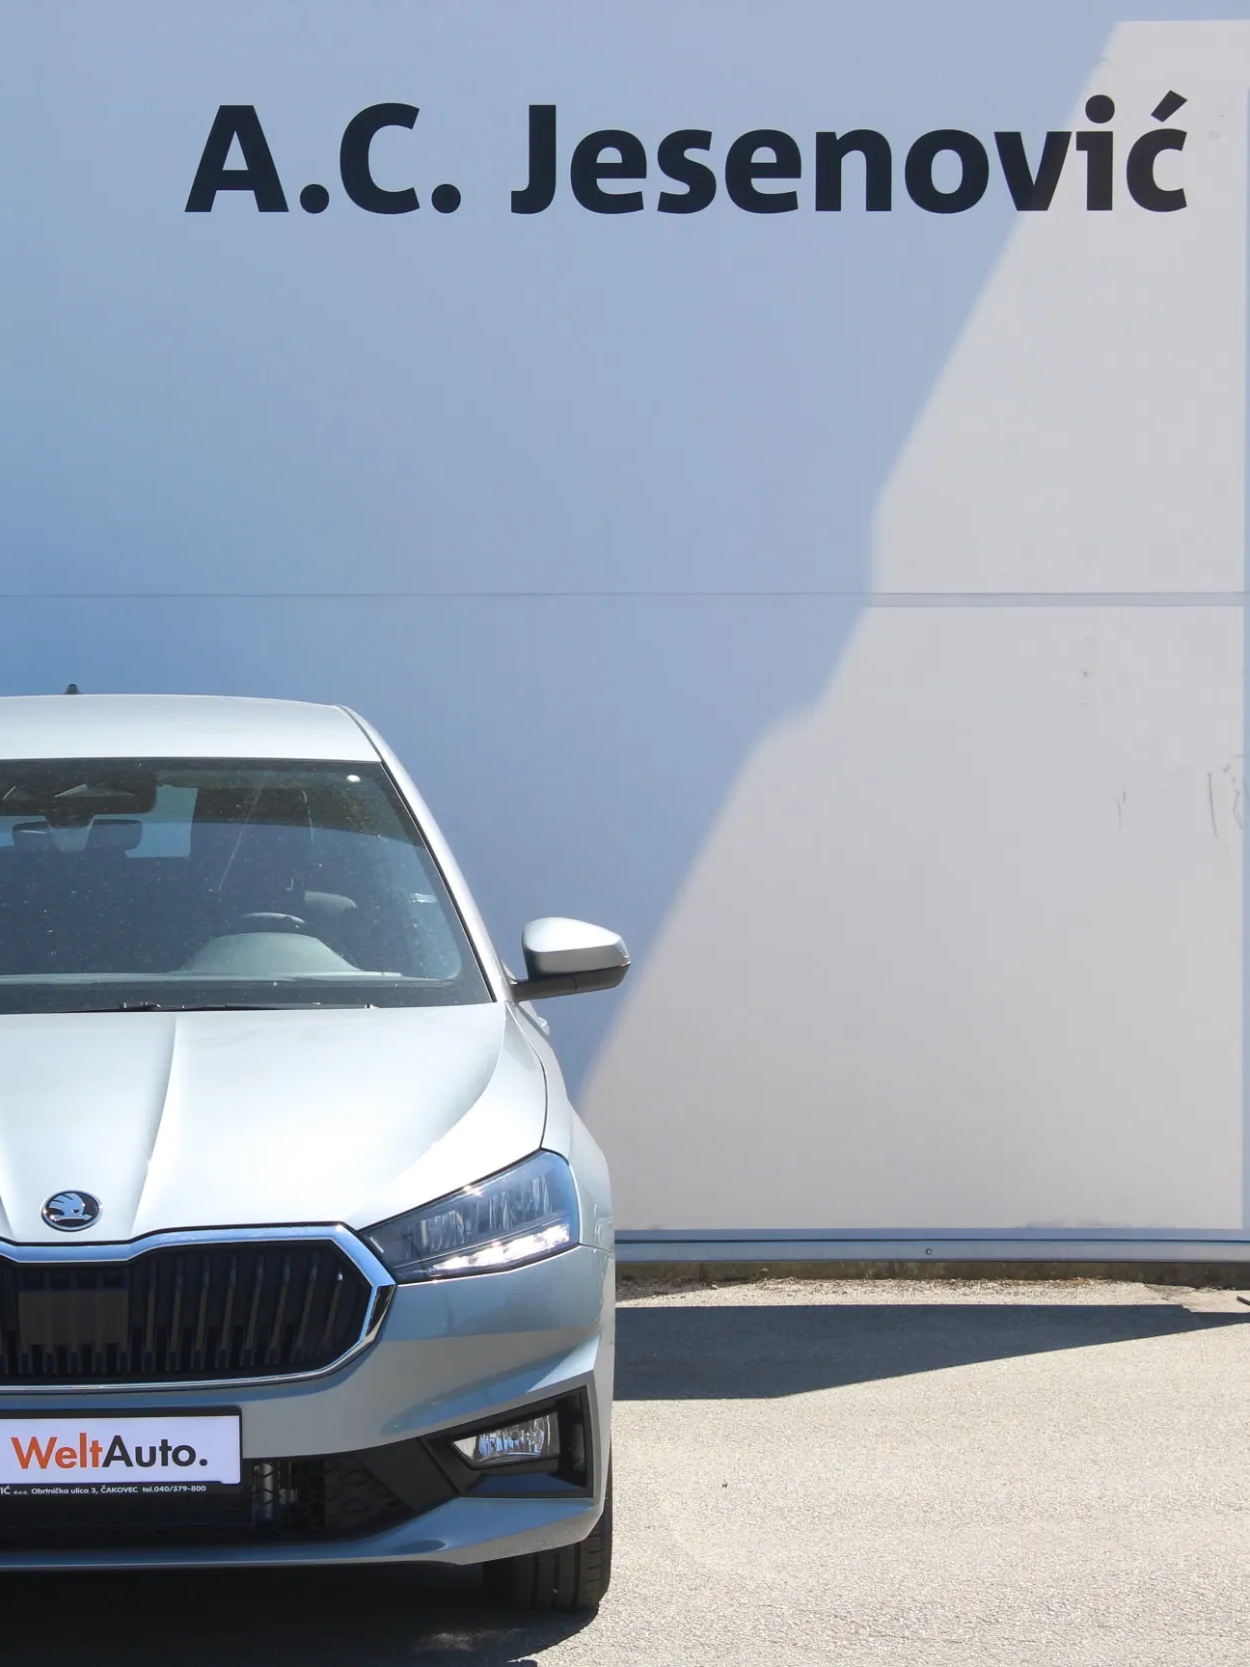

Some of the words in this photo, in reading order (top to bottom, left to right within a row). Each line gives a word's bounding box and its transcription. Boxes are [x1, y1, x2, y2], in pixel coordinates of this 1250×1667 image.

[184, 103, 462, 215] A.C.
[510, 90, 1188, 215] Jesenović
[11, 1432, 208, 1469] WeltAuto.
[30, 1486, 69, 1496] Obrtnička
[70, 1486, 90, 1495] ulica
[100, 1484, 139, 1494] ČAKOVEC
